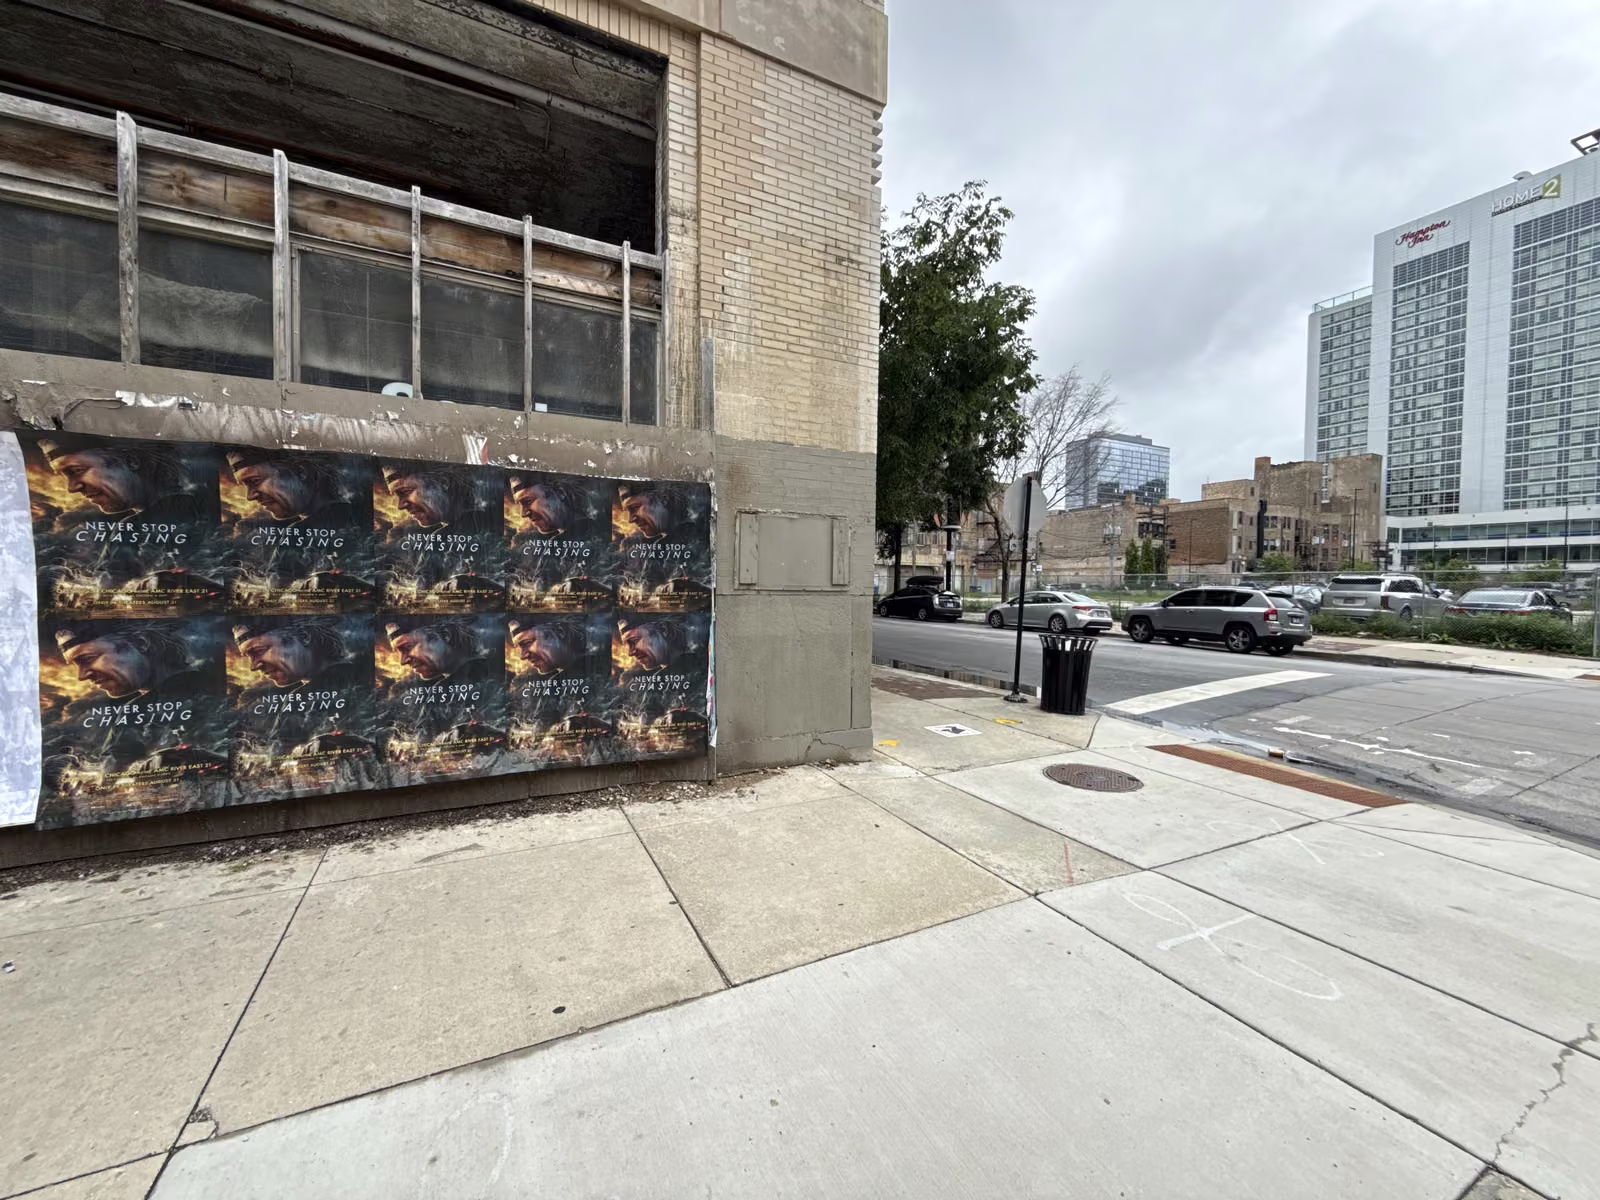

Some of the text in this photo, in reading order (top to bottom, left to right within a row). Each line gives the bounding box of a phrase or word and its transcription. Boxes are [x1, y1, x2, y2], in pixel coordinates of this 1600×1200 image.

[1395, 219, 1451, 246] Hampton
[1408, 233, 1434, 248] Inn
[85, 521, 177, 533] NEVER STOP
[259, 527, 336, 538] NEVER STOP
[75, 530, 188, 545] CHASING
[251, 535, 344, 548] CHASING
[408, 533, 473, 543] NEVER STOP
[401, 541, 479, 552] CHASING
[528, 539, 585, 549] NEVER STOP
[635, 543, 686, 551] NEVER STOP
[522, 546, 591, 557] CHASING
[630, 550, 691, 559] CHASING
[528, 678, 584, 688] NEVER STOP
[634, 674, 685, 683] NEVER STOP
[409, 684, 474, 695] NEVER STOP
[522, 685, 590, 697] CHASING
[629, 681, 690, 692] CHASING
[262, 691, 338, 703] NEVER STOP
[402, 691, 480, 705] CHASING
[92, 701, 183, 716] NEVER STOP
[254, 698, 346, 714] CHASING
[83, 709, 192, 728] CHASING
